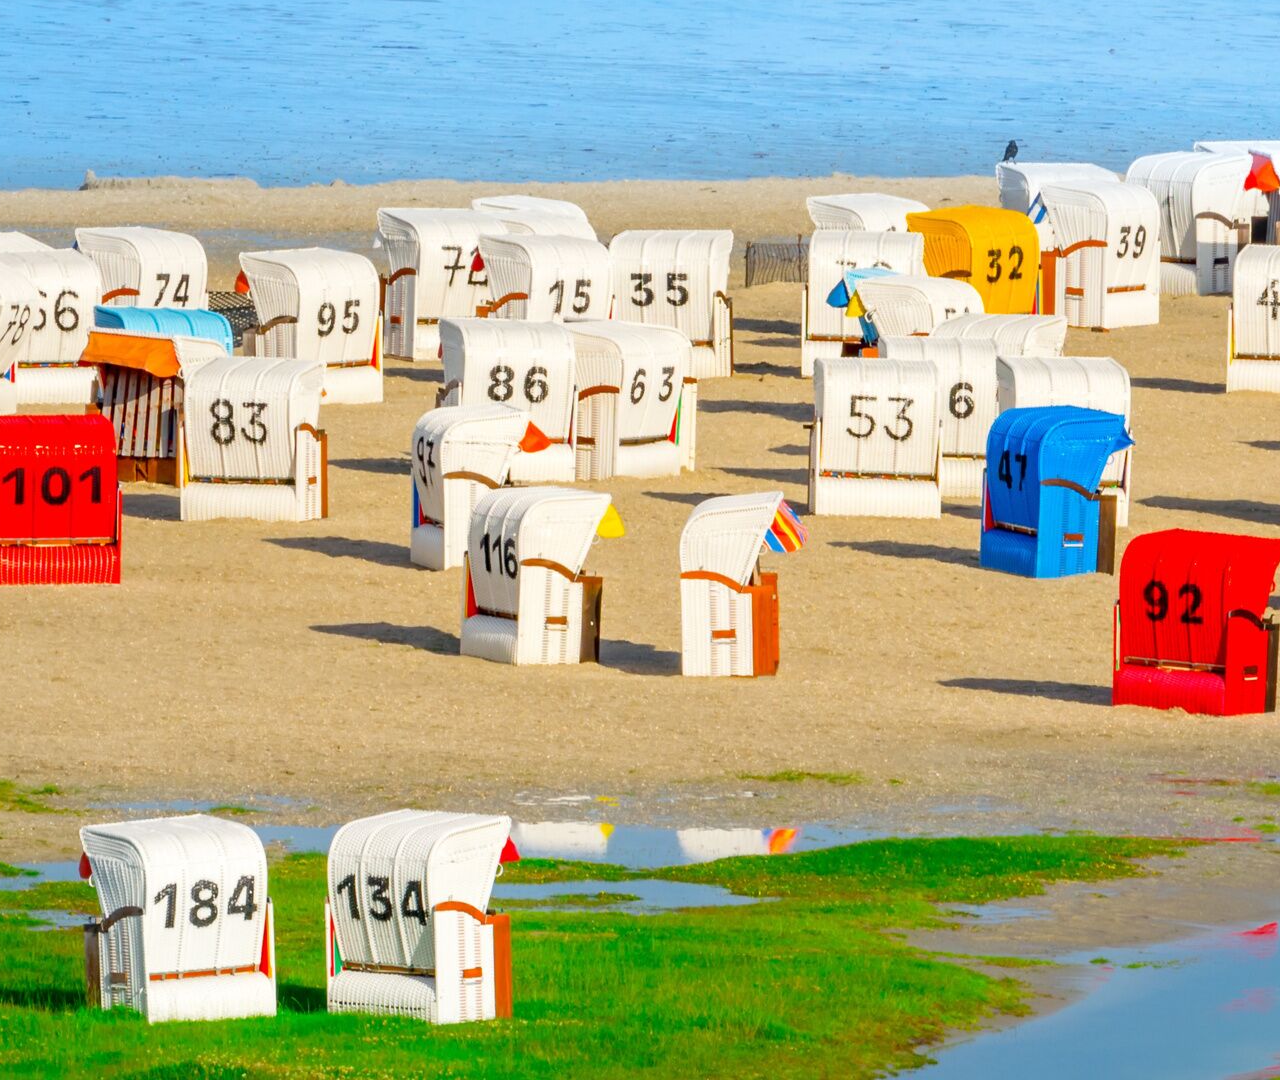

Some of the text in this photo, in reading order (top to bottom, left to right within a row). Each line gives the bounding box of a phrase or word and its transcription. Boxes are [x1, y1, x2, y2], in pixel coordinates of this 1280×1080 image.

[1116, 225, 1147, 259] 39
[986, 246, 1024, 283] 32
[155, 273, 190, 307] 74
[549, 279, 592, 314] 15
[630, 272, 688, 307] 35
[0, 304, 30, 346] 78
[317, 299, 361, 337] 95
[487, 365, 549, 403] 86
[630, 366, 675, 404] 63
[211, 398, 269, 445] 83
[846, 395, 914, 442] 53
[1, 466, 102, 505] 101
[998, 450, 1027, 490] 47
[479, 532, 518, 580] 116
[1142, 580, 1204, 624] 92
[154, 875, 257, 928] 184
[337, 873, 428, 926] 134
